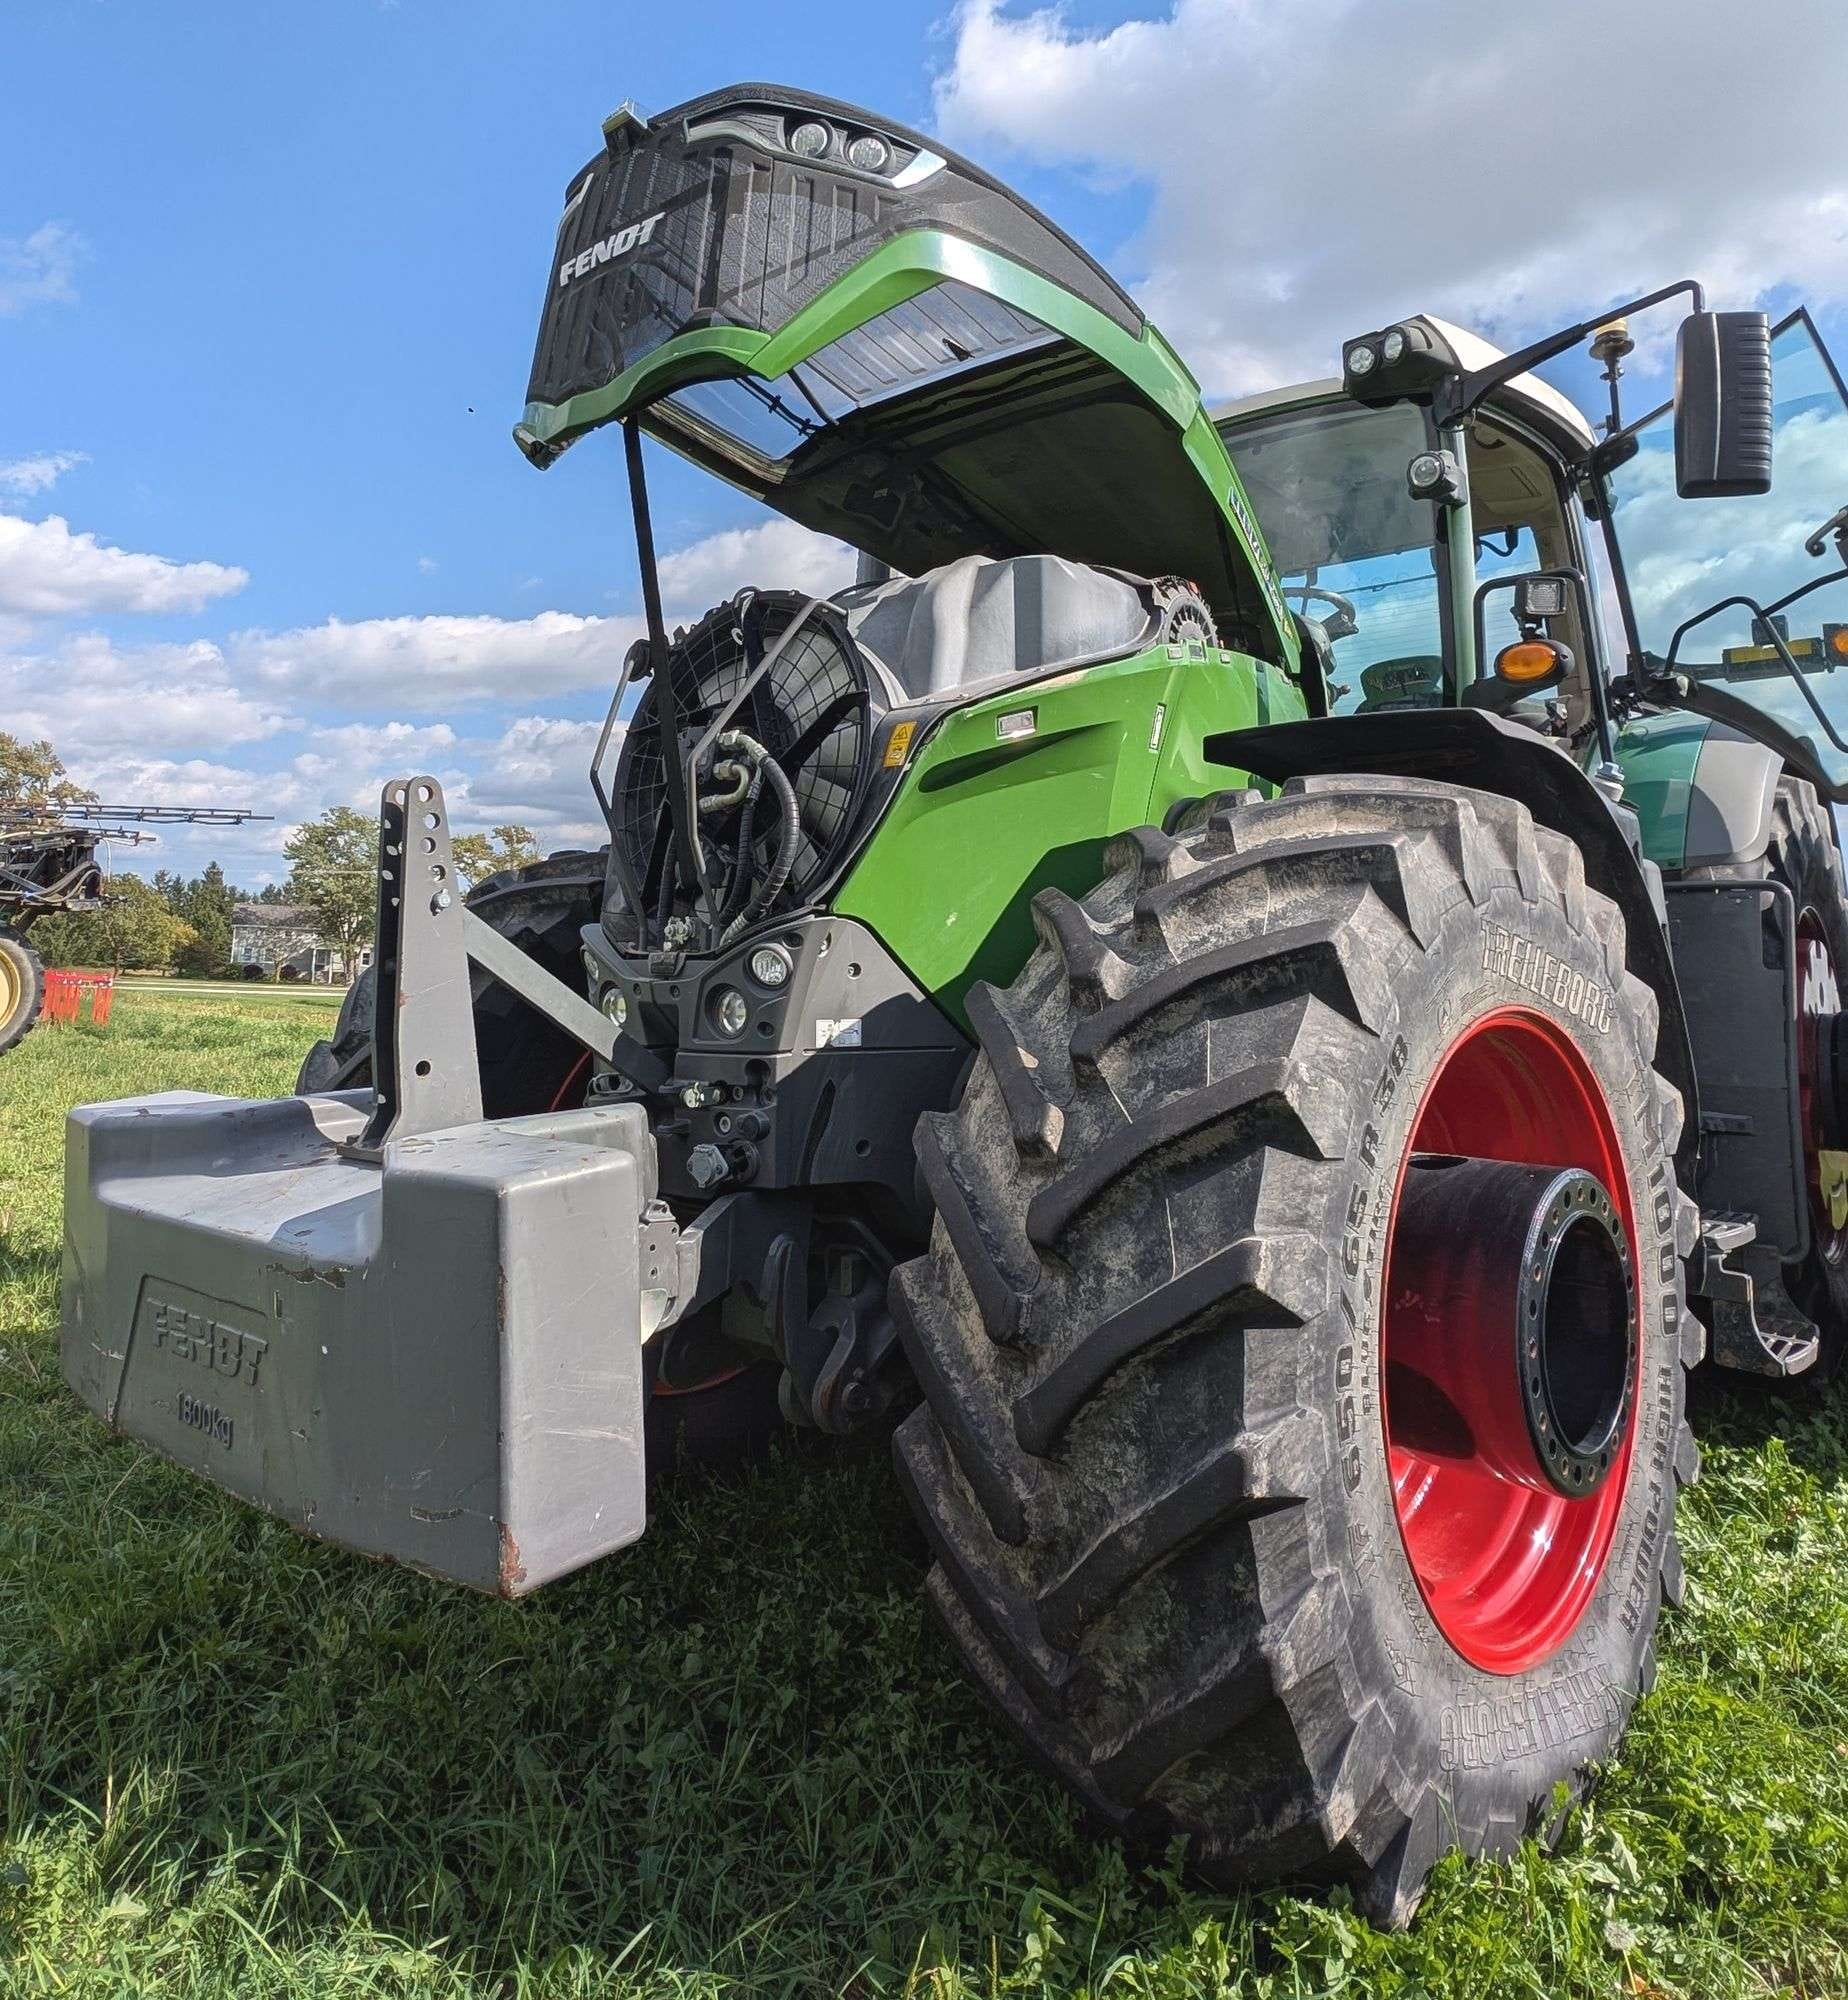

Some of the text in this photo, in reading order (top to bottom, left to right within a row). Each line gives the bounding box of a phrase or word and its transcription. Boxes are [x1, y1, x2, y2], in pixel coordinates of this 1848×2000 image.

[560, 211, 666, 287] FENDT
[1480, 917, 1617, 1035] TRELLEBORG
[147, 1297, 269, 1387] FENDT
[175, 1390, 234, 1451] 1800kg
[1650, 1363, 1673, 1475] HIGH
[1616, 1480, 1663, 1639] POWER
[1438, 1662, 1623, 1773] TRELLEBORG
